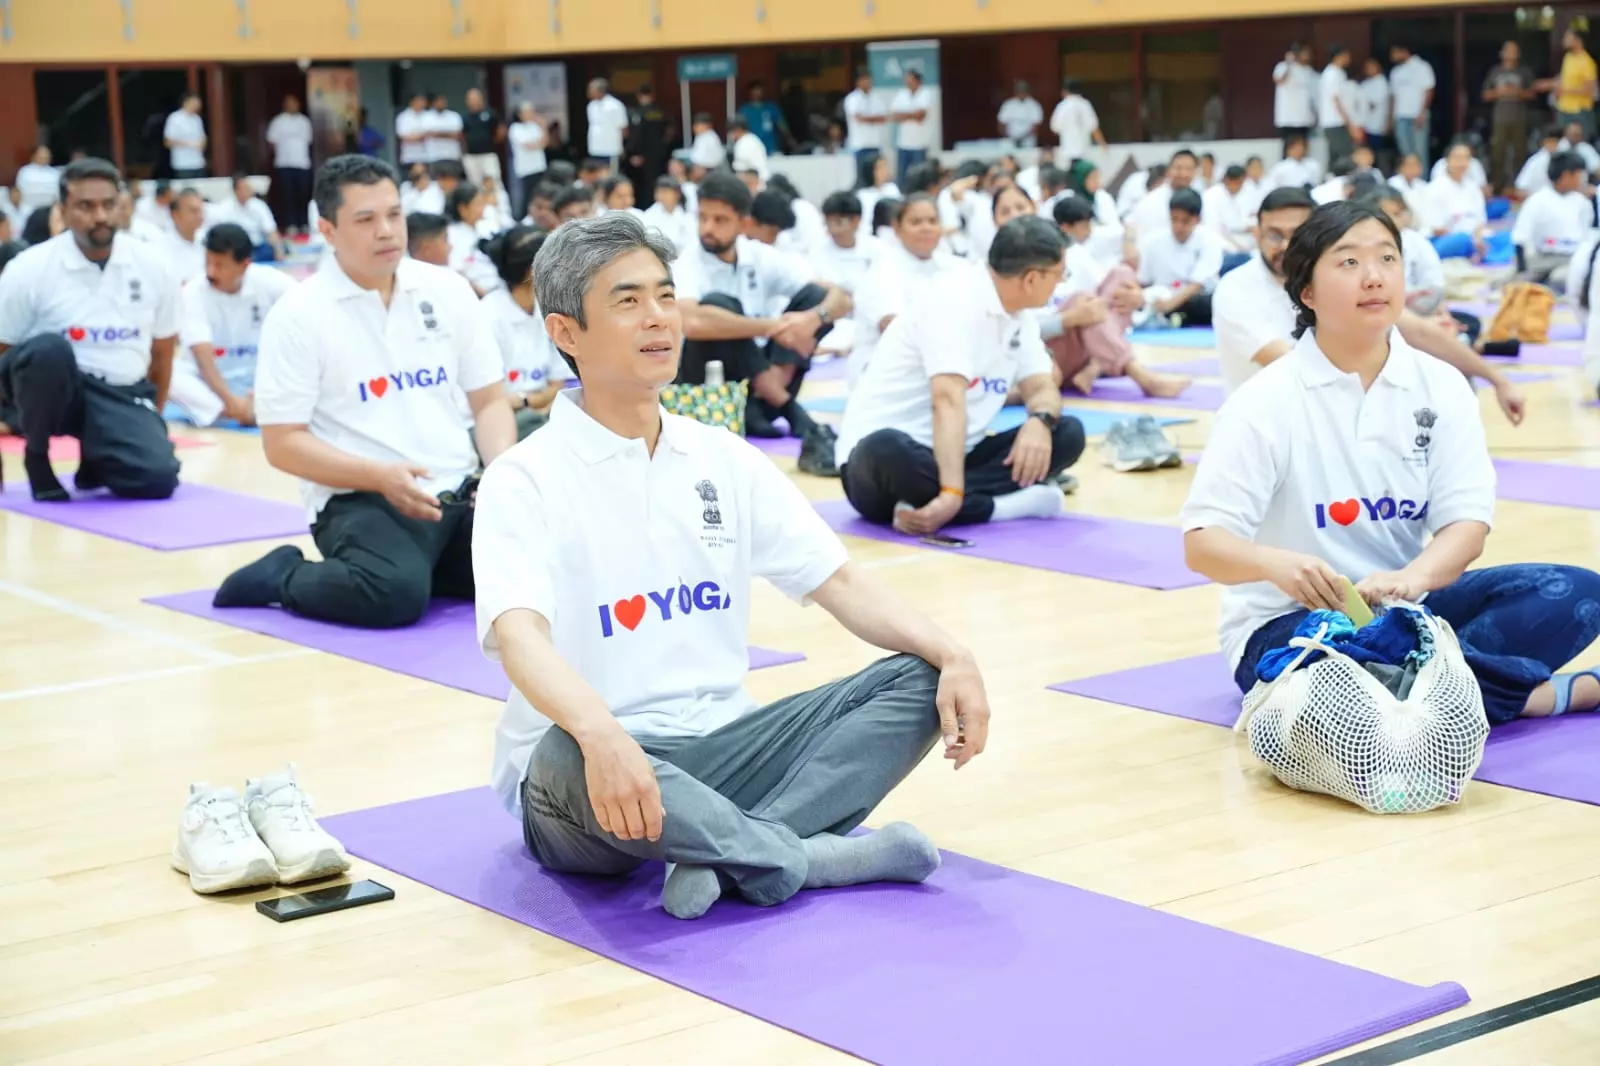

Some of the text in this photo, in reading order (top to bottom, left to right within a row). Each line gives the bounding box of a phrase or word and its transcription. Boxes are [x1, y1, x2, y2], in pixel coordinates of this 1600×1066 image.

[358, 382, 368, 402] I
[1315, 503, 1327, 529] I
[598, 603, 614, 638] I
